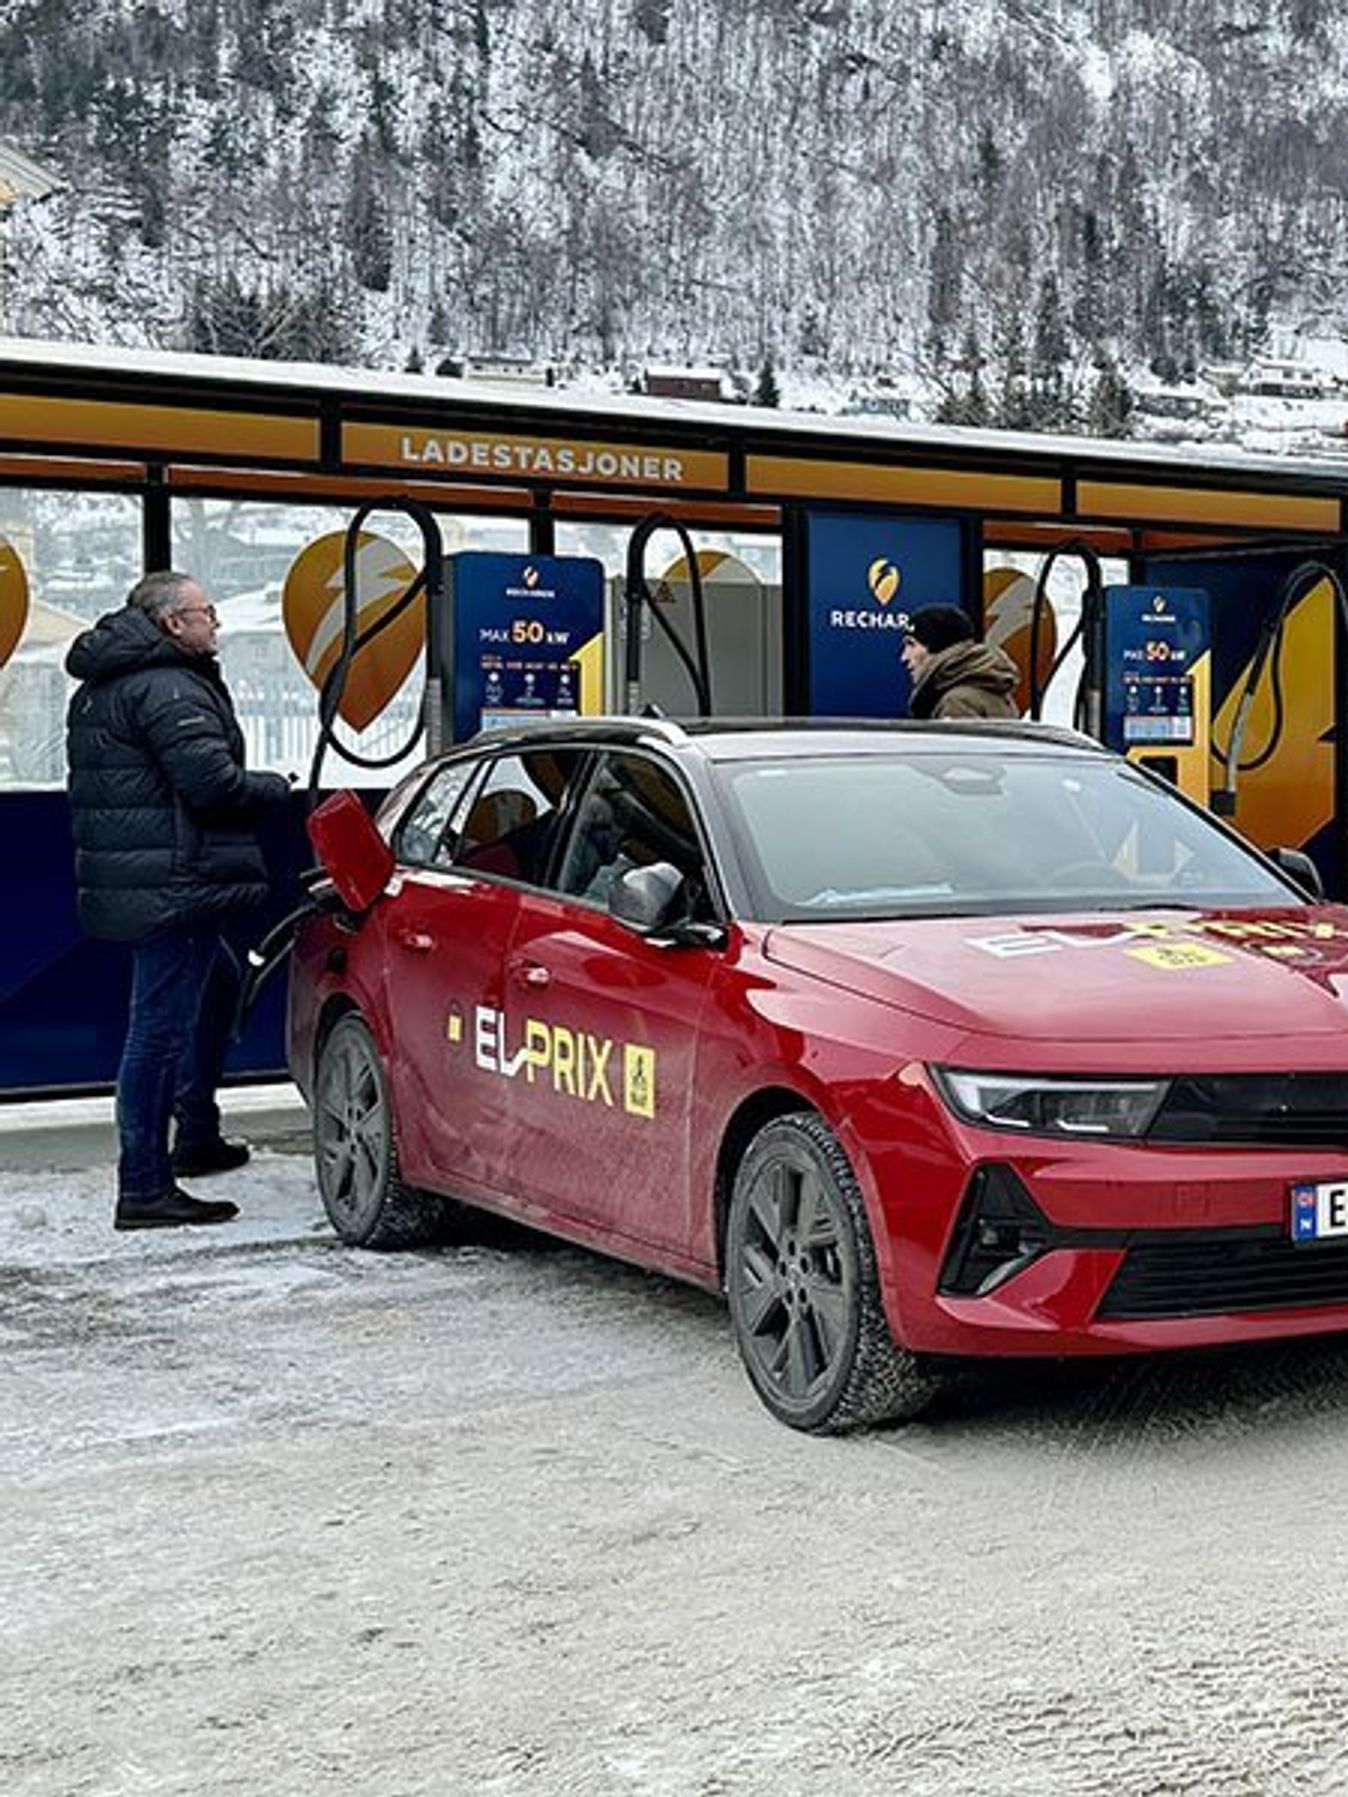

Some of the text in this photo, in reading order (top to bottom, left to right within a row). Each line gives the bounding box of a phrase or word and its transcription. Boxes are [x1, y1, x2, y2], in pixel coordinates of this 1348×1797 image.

[401, 436, 683, 481] LADESTASJONER
[479, 628, 509, 642] MAX
[512, 619, 544, 643] 50
[829, 610, 915, 632] RECHAR
[1146, 641, 1169, 661] 50
